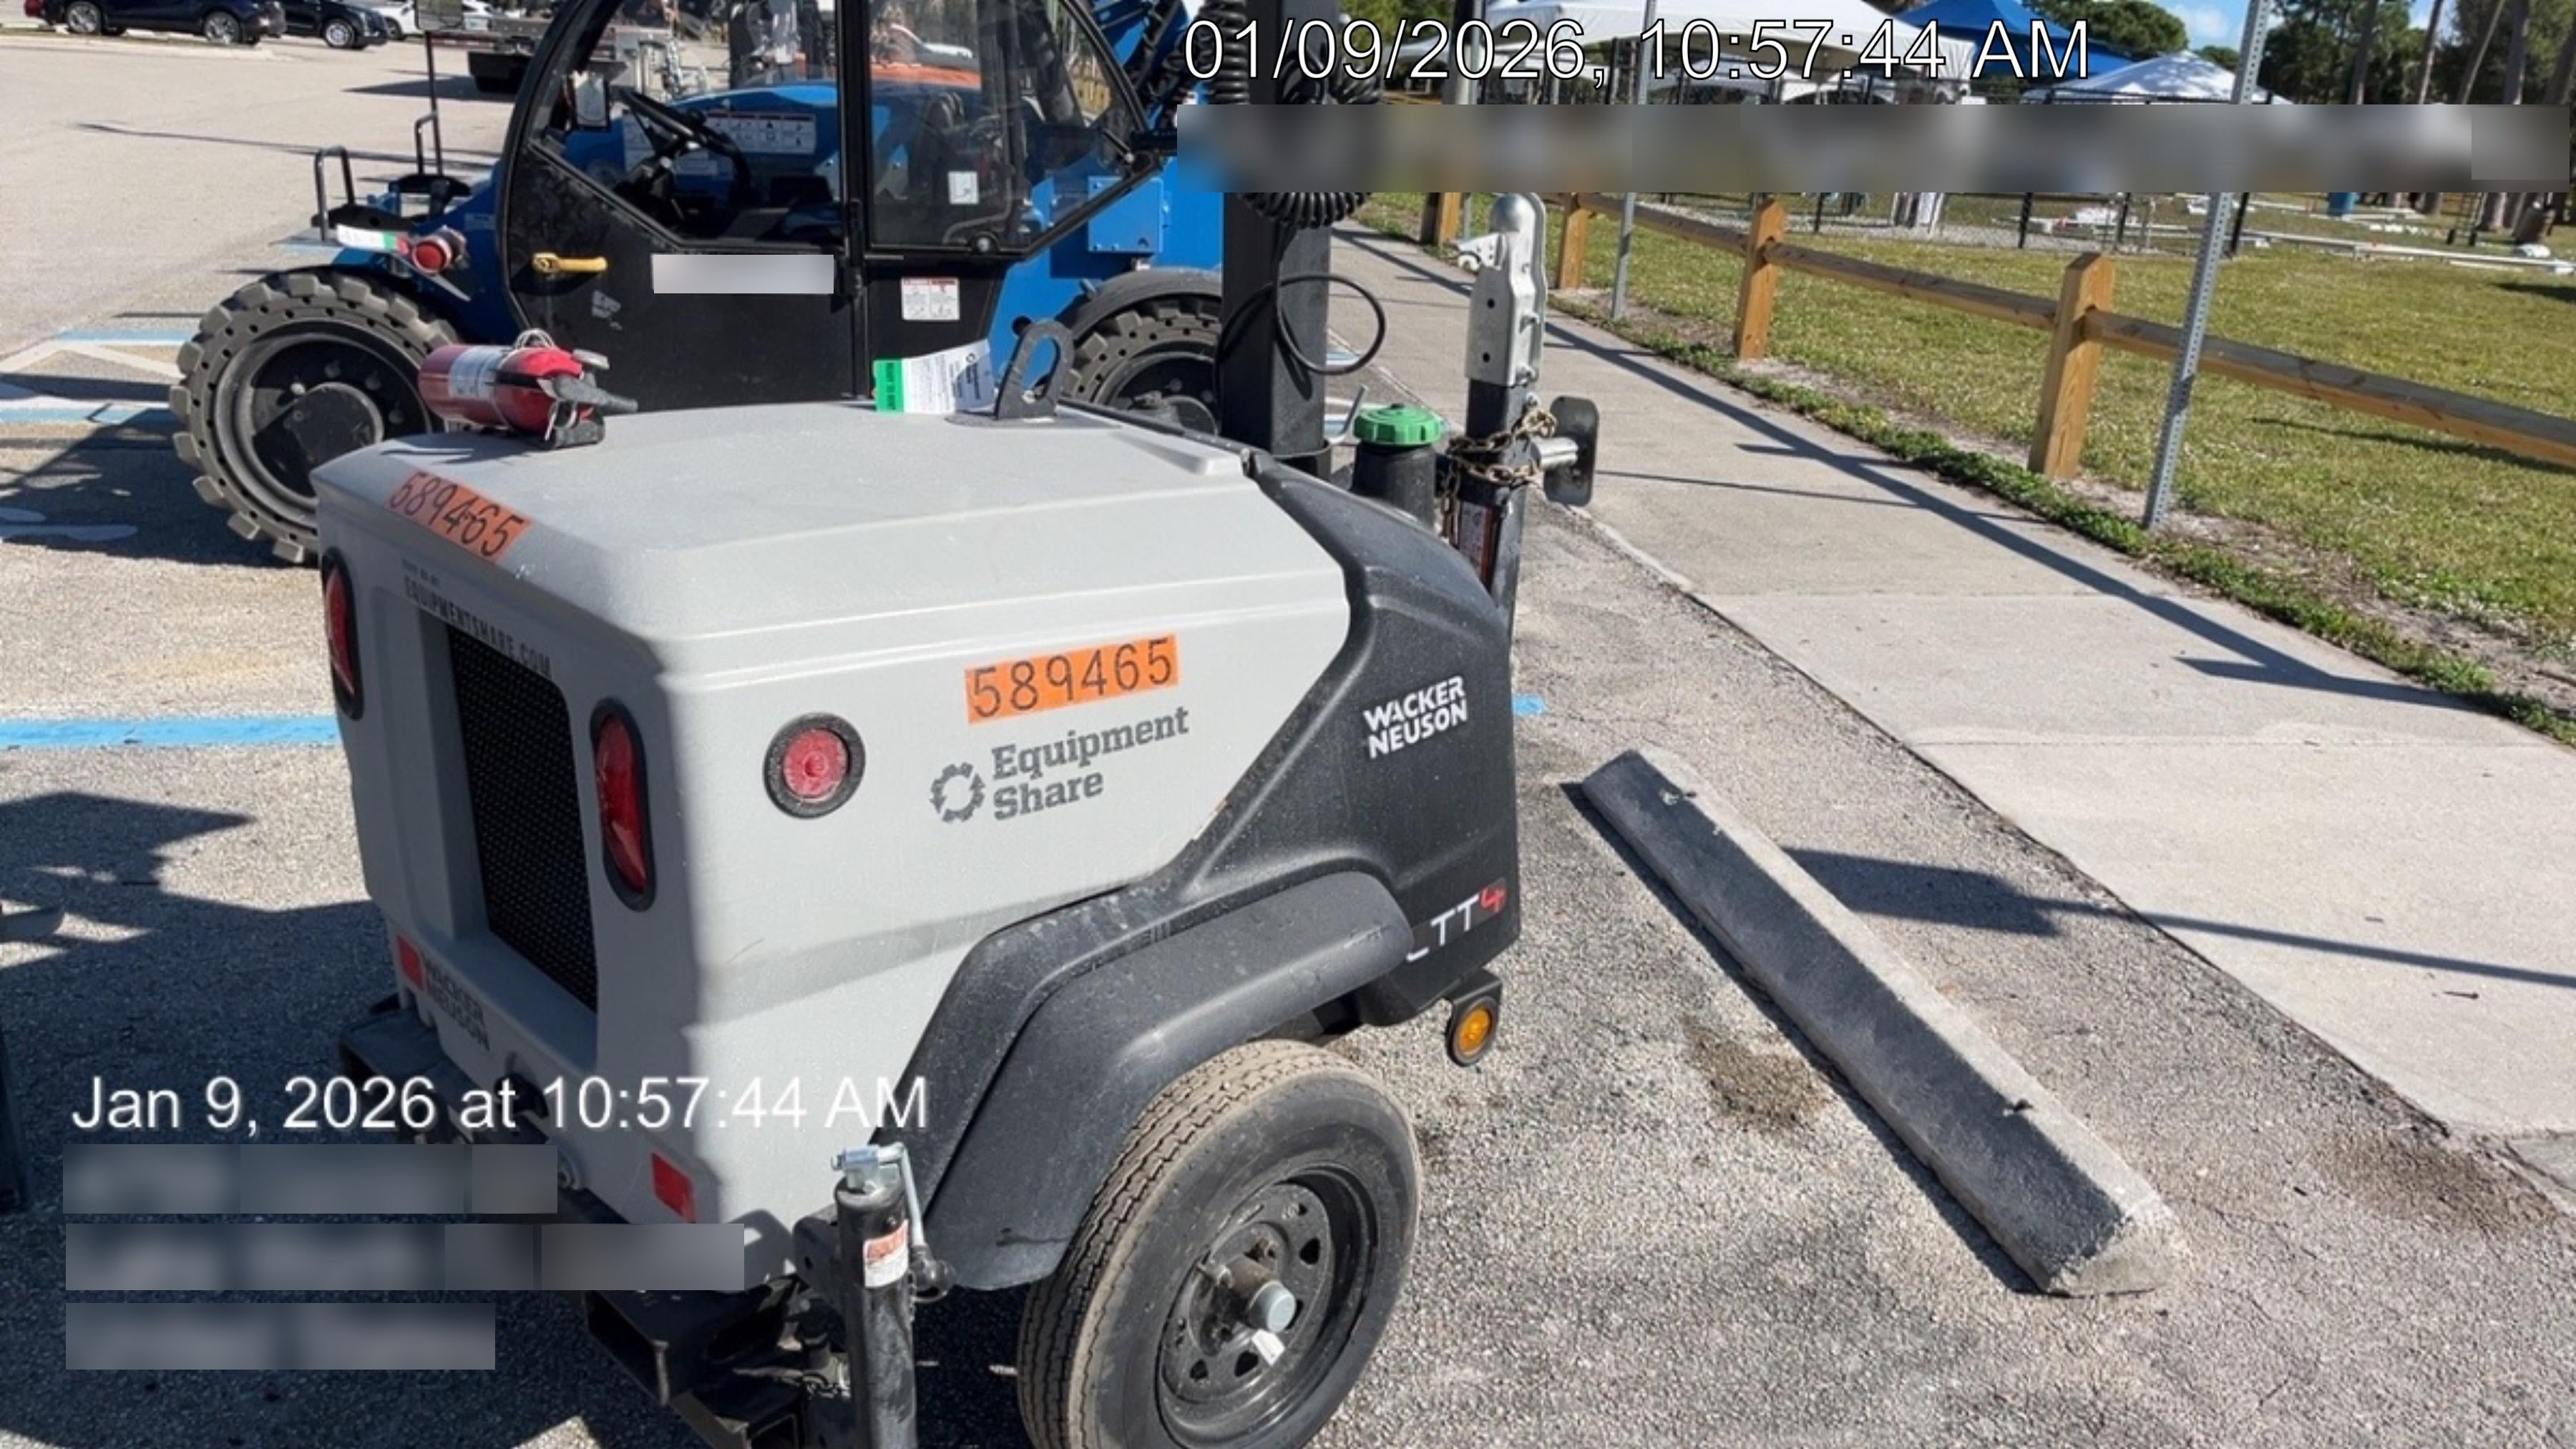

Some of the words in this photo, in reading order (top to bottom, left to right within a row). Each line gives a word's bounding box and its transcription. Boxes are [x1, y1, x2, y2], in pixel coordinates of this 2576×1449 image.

[389, 471, 525, 557] 589465
[973, 636, 1174, 718] 589465
[1362, 675, 1466, 732] WACKER
[991, 705, 1190, 780] Equipment
[1368, 698, 1468, 759] NEUSON
[992, 771, 1106, 821] Share
